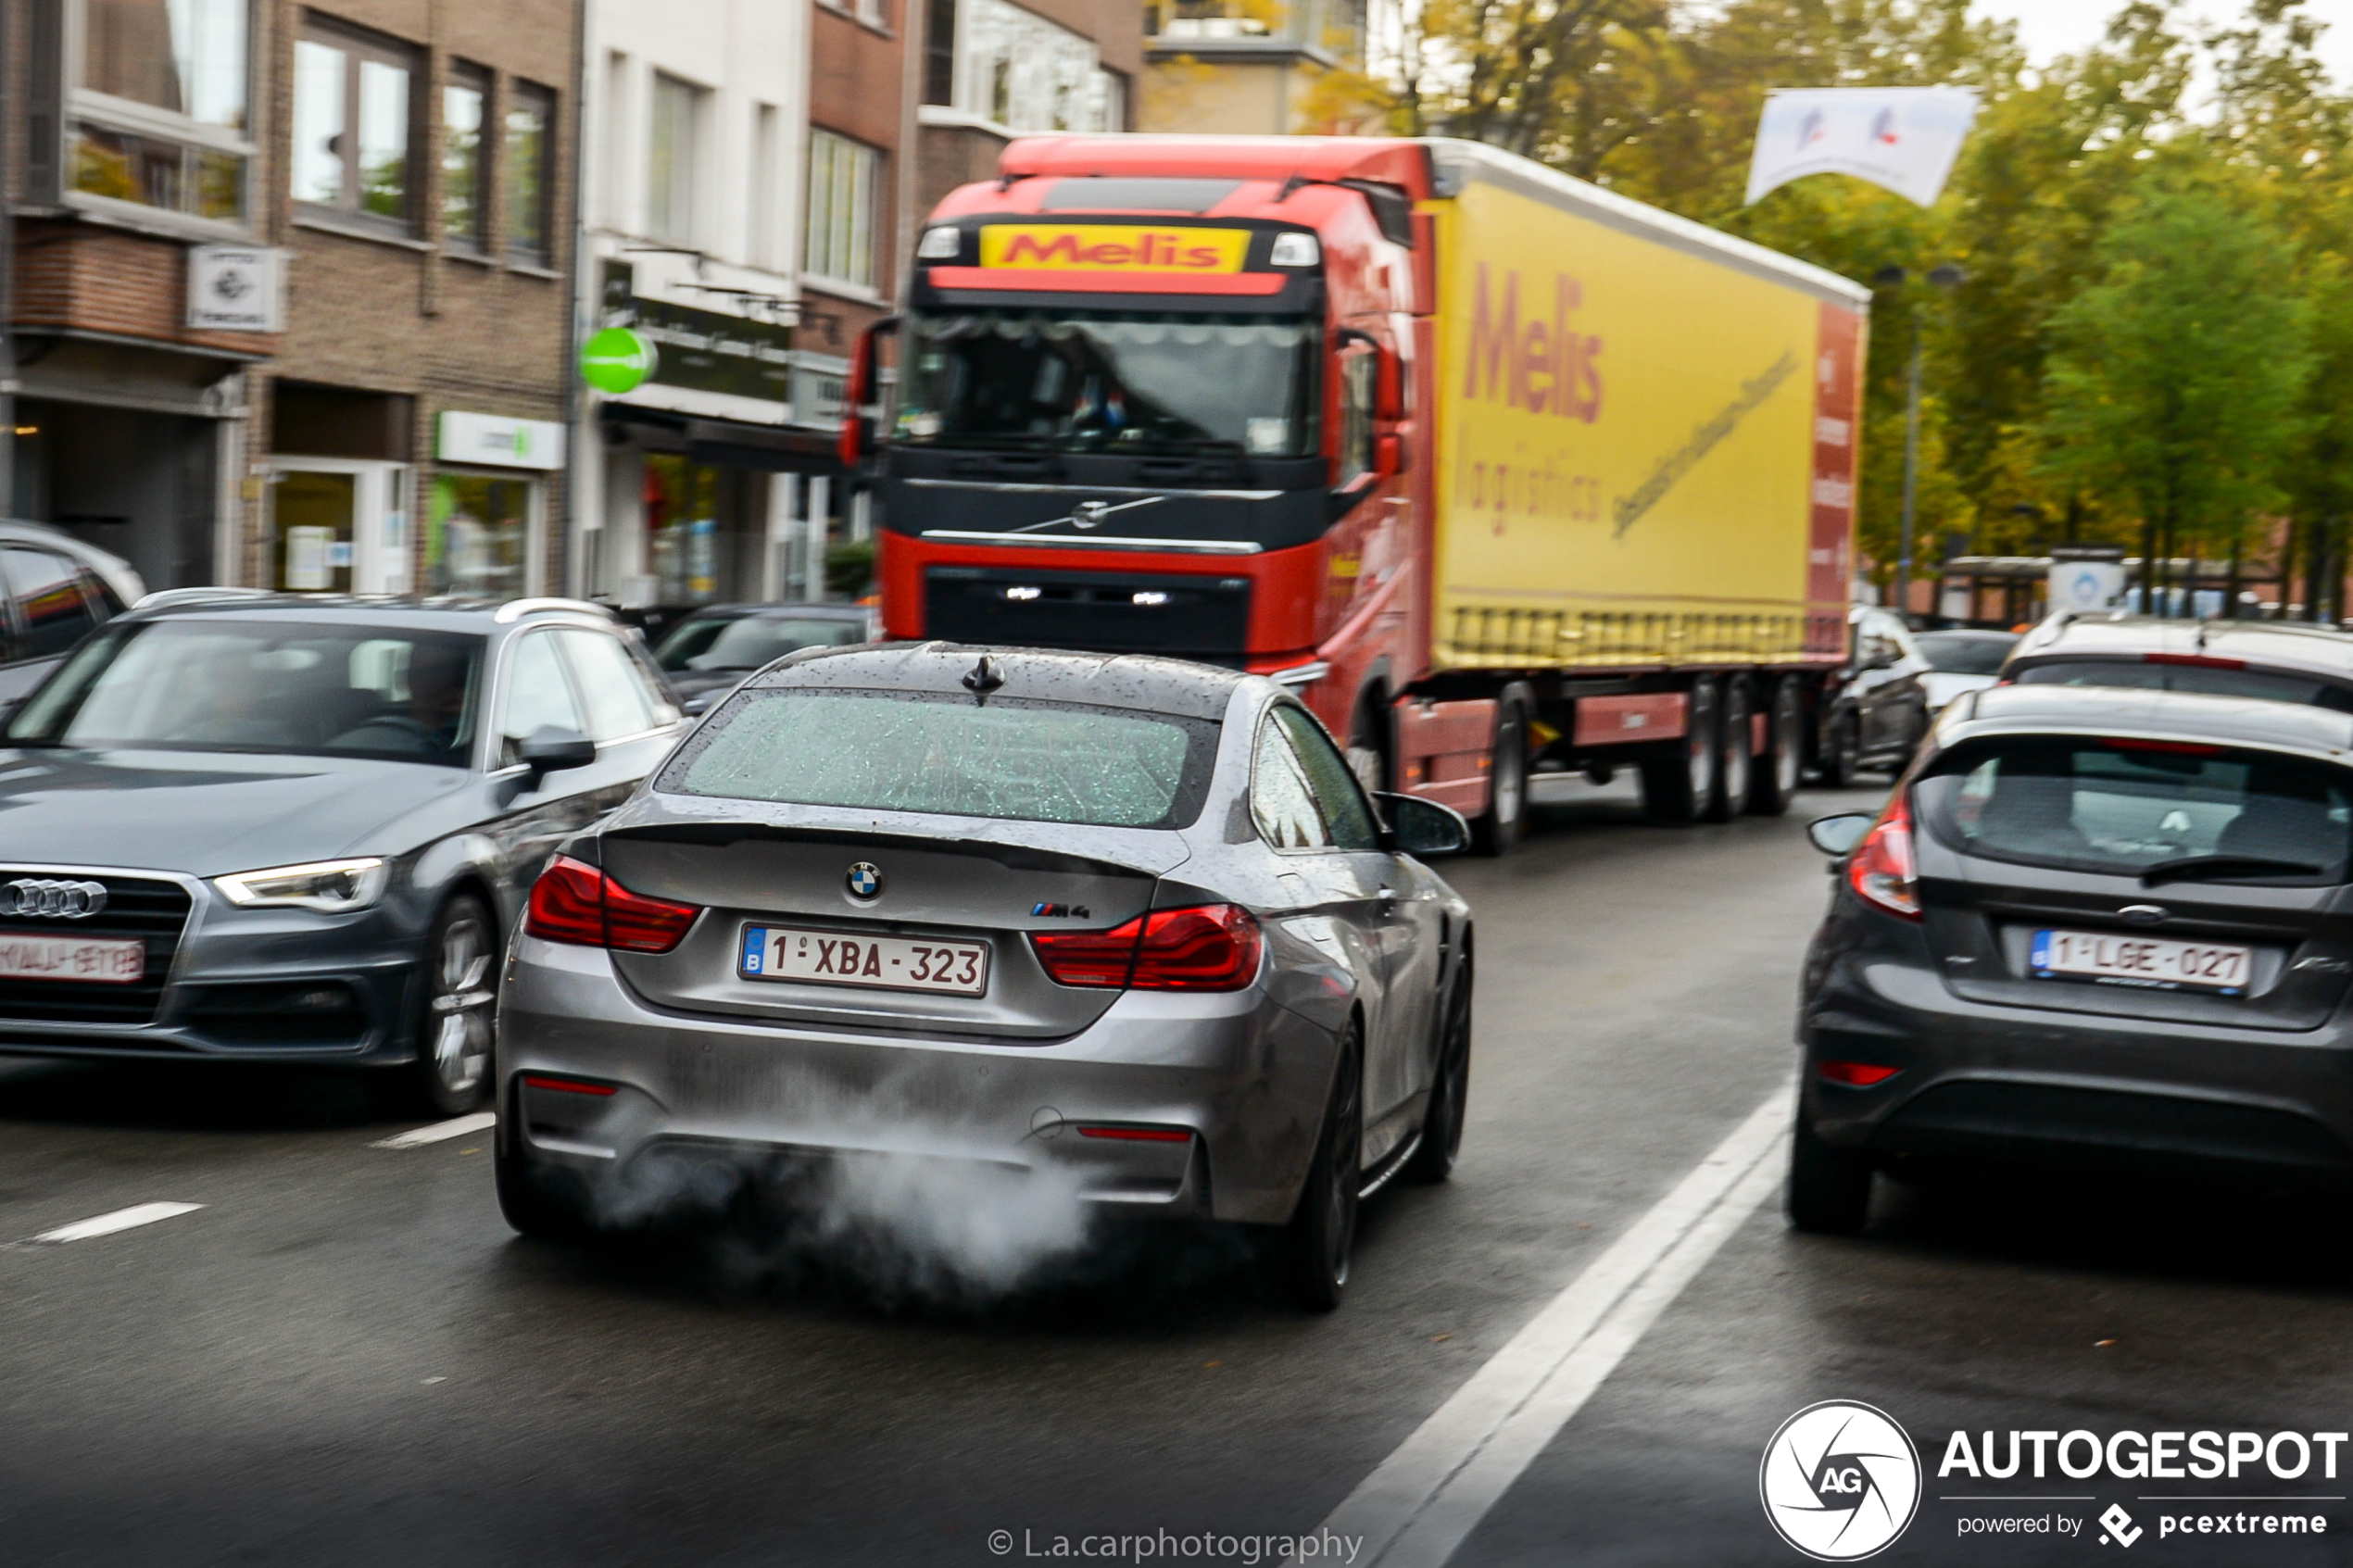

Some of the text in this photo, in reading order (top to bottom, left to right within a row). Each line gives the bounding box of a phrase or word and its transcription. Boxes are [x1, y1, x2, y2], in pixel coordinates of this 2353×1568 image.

[1000, 233, 1222, 268] Melis
[1463, 259, 1603, 424] Melis
[1045, 902, 1090, 919] M4
[747, 954, 760, 972] B
